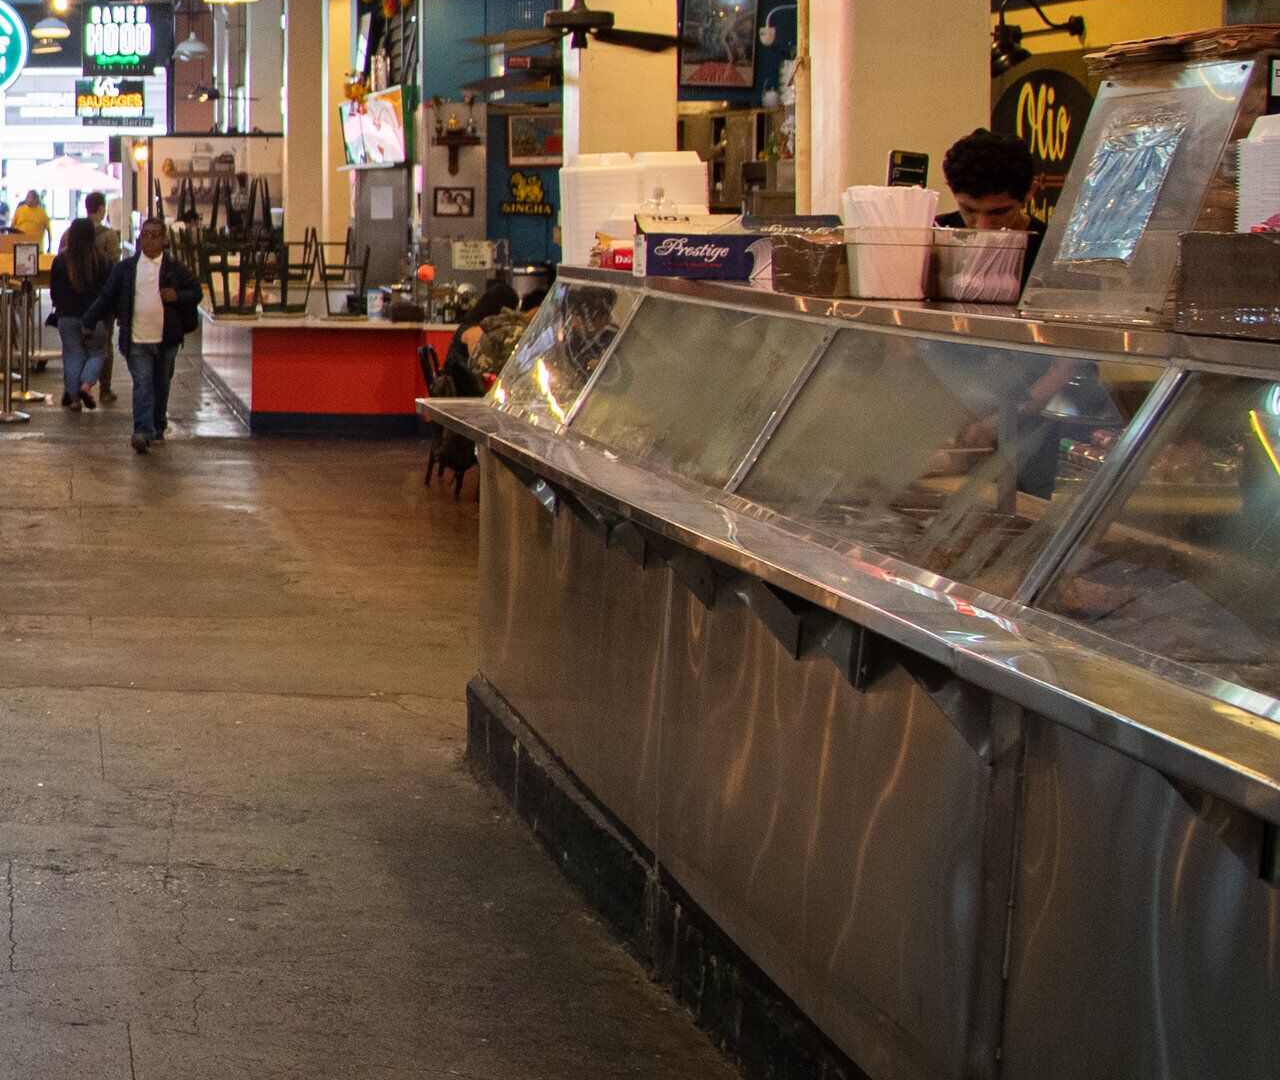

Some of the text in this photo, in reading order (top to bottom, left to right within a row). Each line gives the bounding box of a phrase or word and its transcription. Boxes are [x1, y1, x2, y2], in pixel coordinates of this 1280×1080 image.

[86, 22, 153, 56] HOOD
[77, 93, 144, 109] SAUSAGES
[1016, 81, 1071, 161] Olio
[502, 202, 552, 214] SINGHA
[653, 236, 730, 263] Prestige
